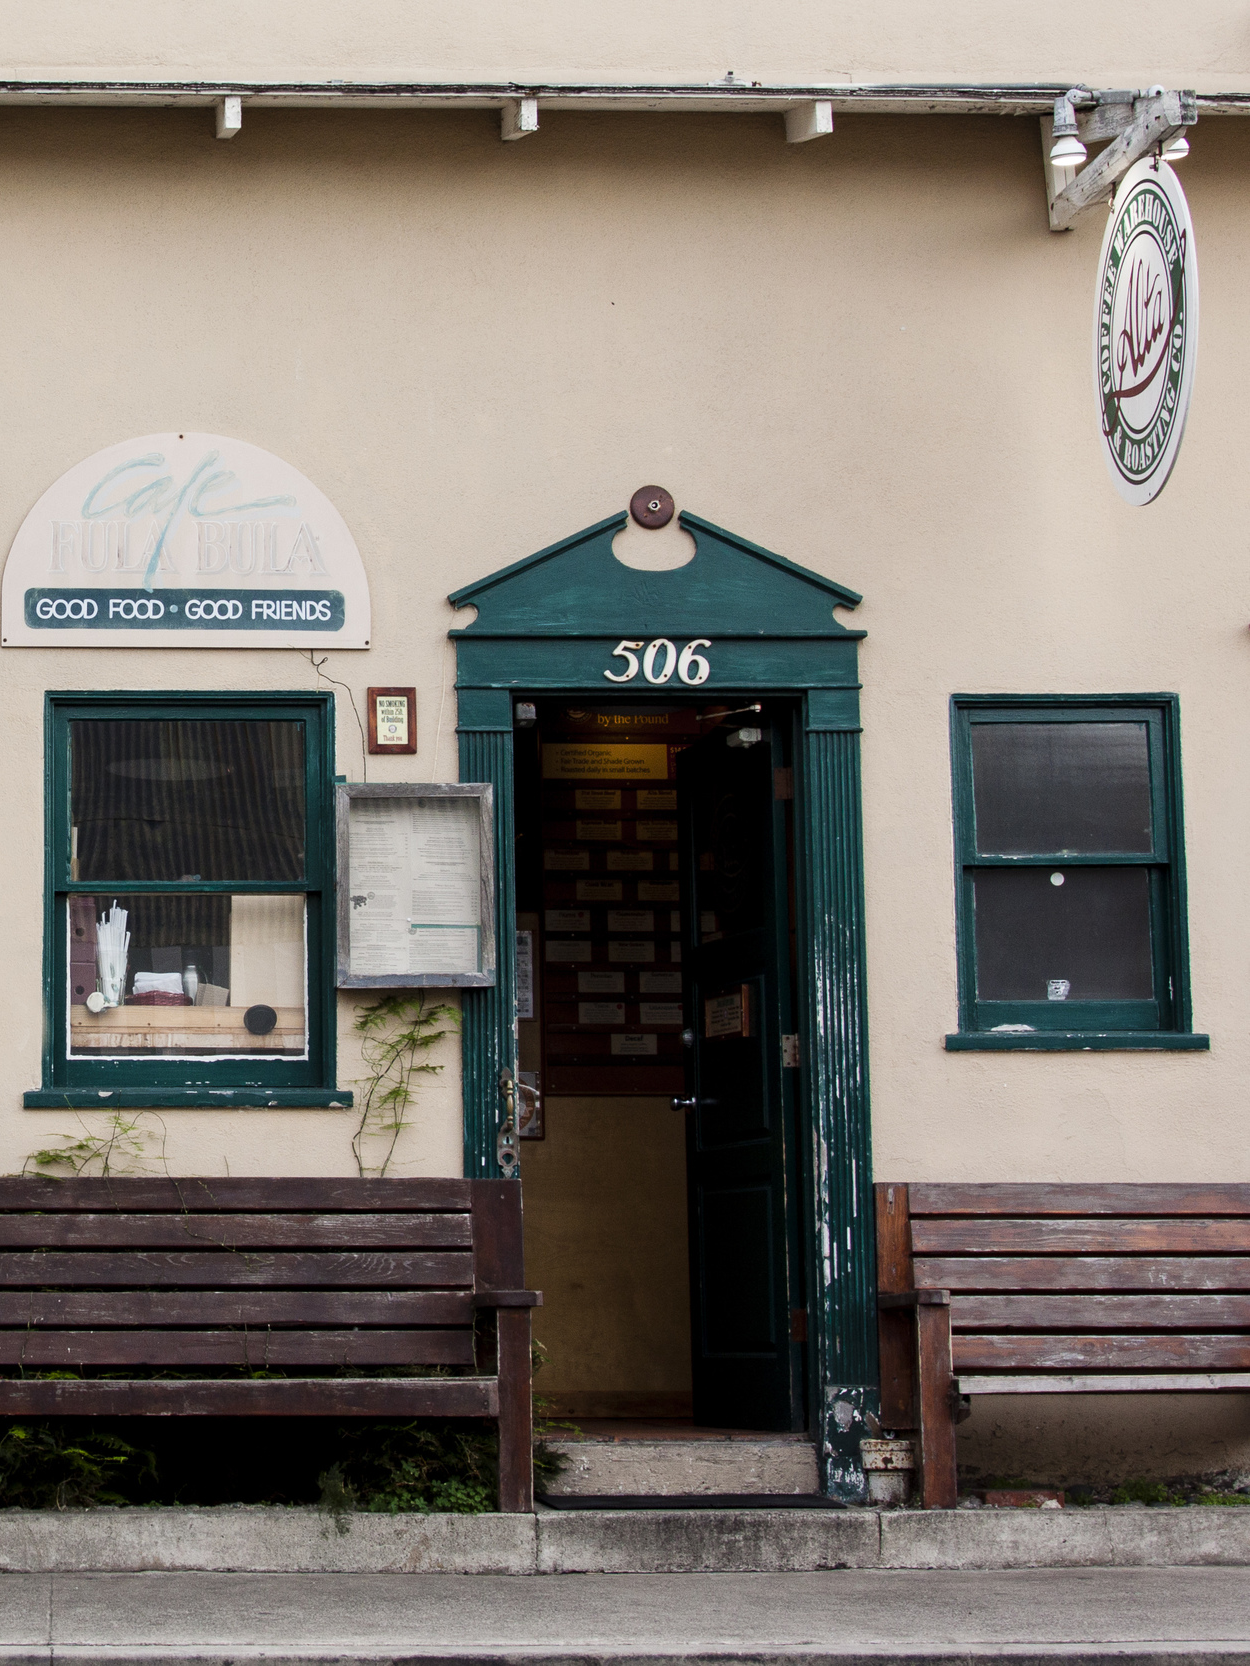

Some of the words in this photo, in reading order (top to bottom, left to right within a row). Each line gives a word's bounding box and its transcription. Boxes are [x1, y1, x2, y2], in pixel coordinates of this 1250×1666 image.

[1100, 259, 1118, 394] COFFEE
[1114, 193, 1179, 271] WAREHOUSE
[1114, 425, 1123, 454] &
[1123, 380, 1176, 471] ROASTING
[80, 449, 300, 594] Cafe
[47, 519, 179, 577] FULA
[194, 519, 332, 578] BULA
[35, 598, 99, 620] GOOD
[108, 598, 165, 620] FOOD
[184, 599, 243, 620] GOOD
[251, 600, 332, 621] FRIENDS
[603, 638, 712, 685] 506
[387, 716, 403, 724] Building
[597, 714, 611, 727] by
[613, 714, 631, 725] the
[634, 714, 669, 725] Pound
[560, 757, 573, 765] Fair
[573, 757, 589, 765] Trade
[590, 757, 602, 765] and
[603, 757, 623, 765] Shade
[587, 749, 612, 758] Organic
[560, 766, 586, 774] Roasted
[587, 766, 601, 774] daily
[609, 766, 625, 774] small
[626, 766, 651, 774] batches
